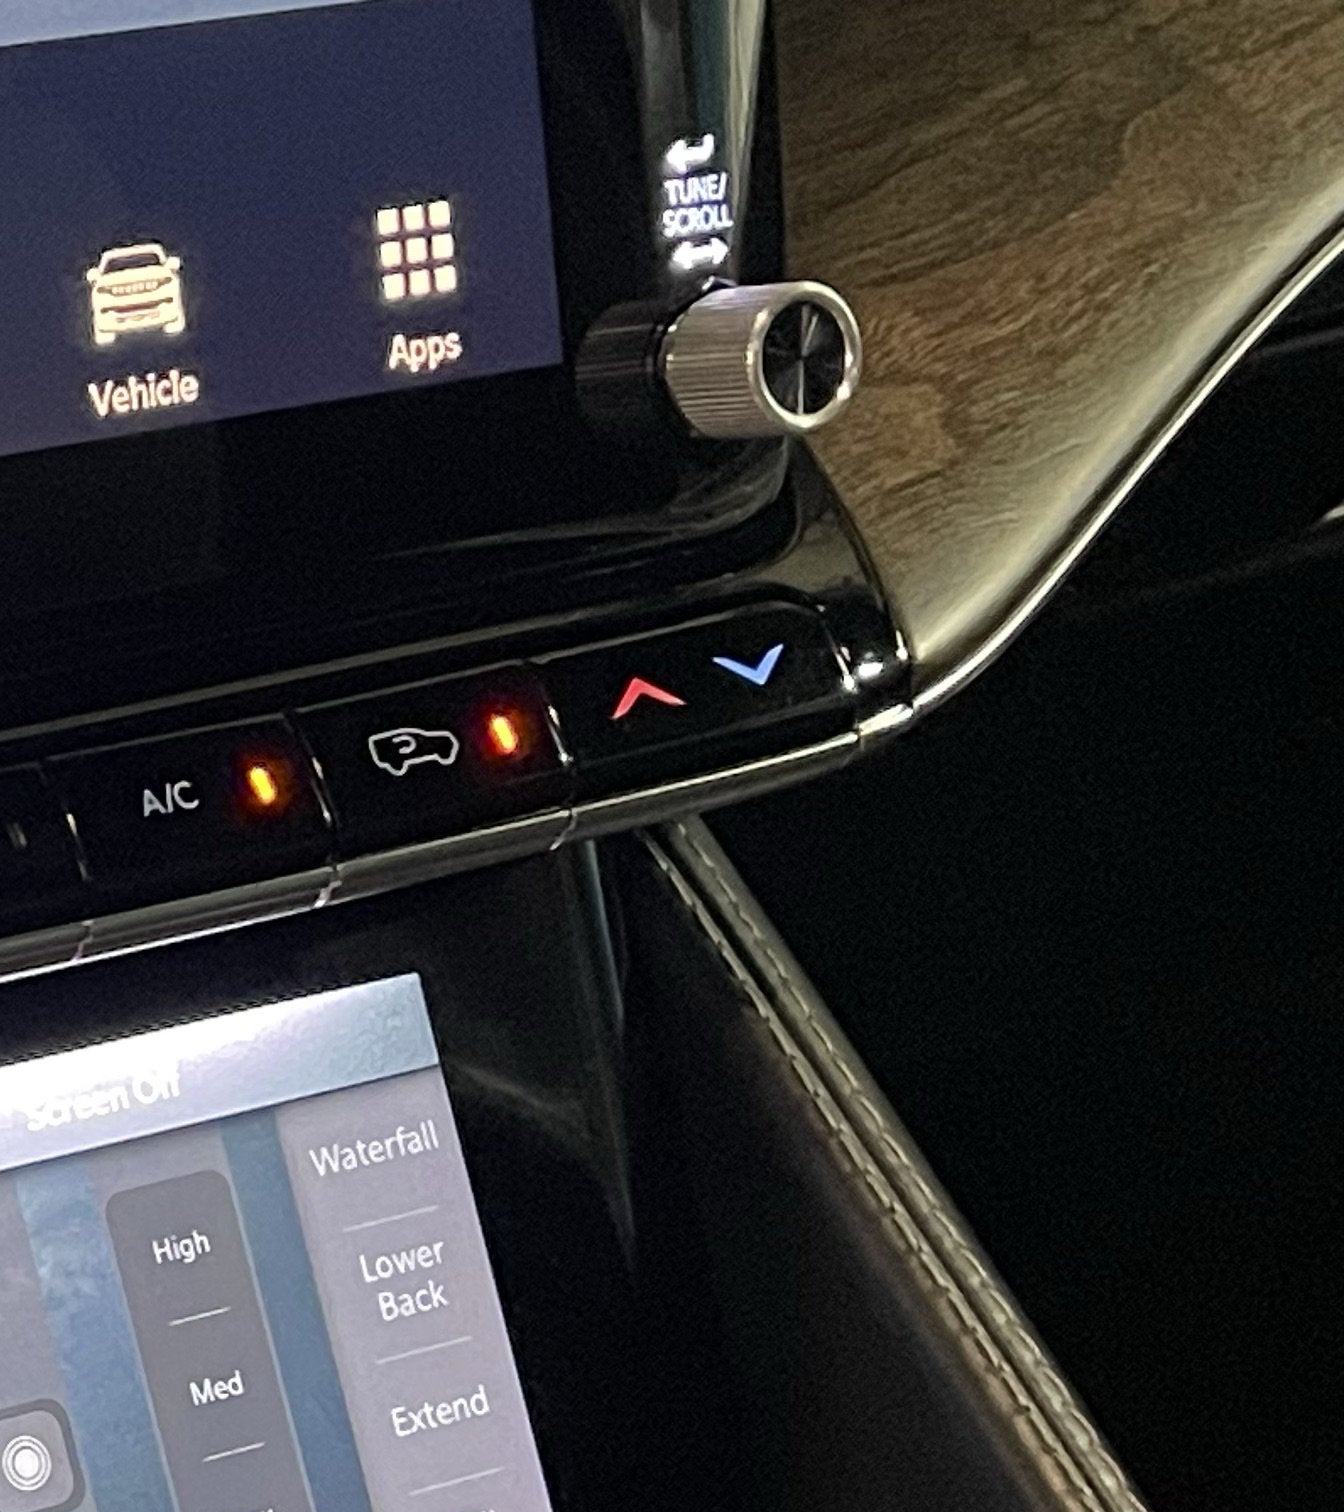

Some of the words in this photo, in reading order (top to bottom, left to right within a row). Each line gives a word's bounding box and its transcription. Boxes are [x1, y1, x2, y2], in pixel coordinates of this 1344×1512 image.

[664, 172, 727, 205] TUNE/
[662, 204, 734, 237] SCROLL
[387, 328, 462, 372] Apps
[88, 369, 200, 419] Vehicle
[142, 780, 200, 817] A/C
[26, 1085, 130, 1131] Screen
[310, 1120, 440, 1177] Waterfall
[151, 1230, 211, 1267] High
[359, 1237, 444, 1283] Lower
[376, 1281, 450, 1322] Back
[189, 1370, 245, 1407] Med
[391, 1385, 491, 1437] Extend
